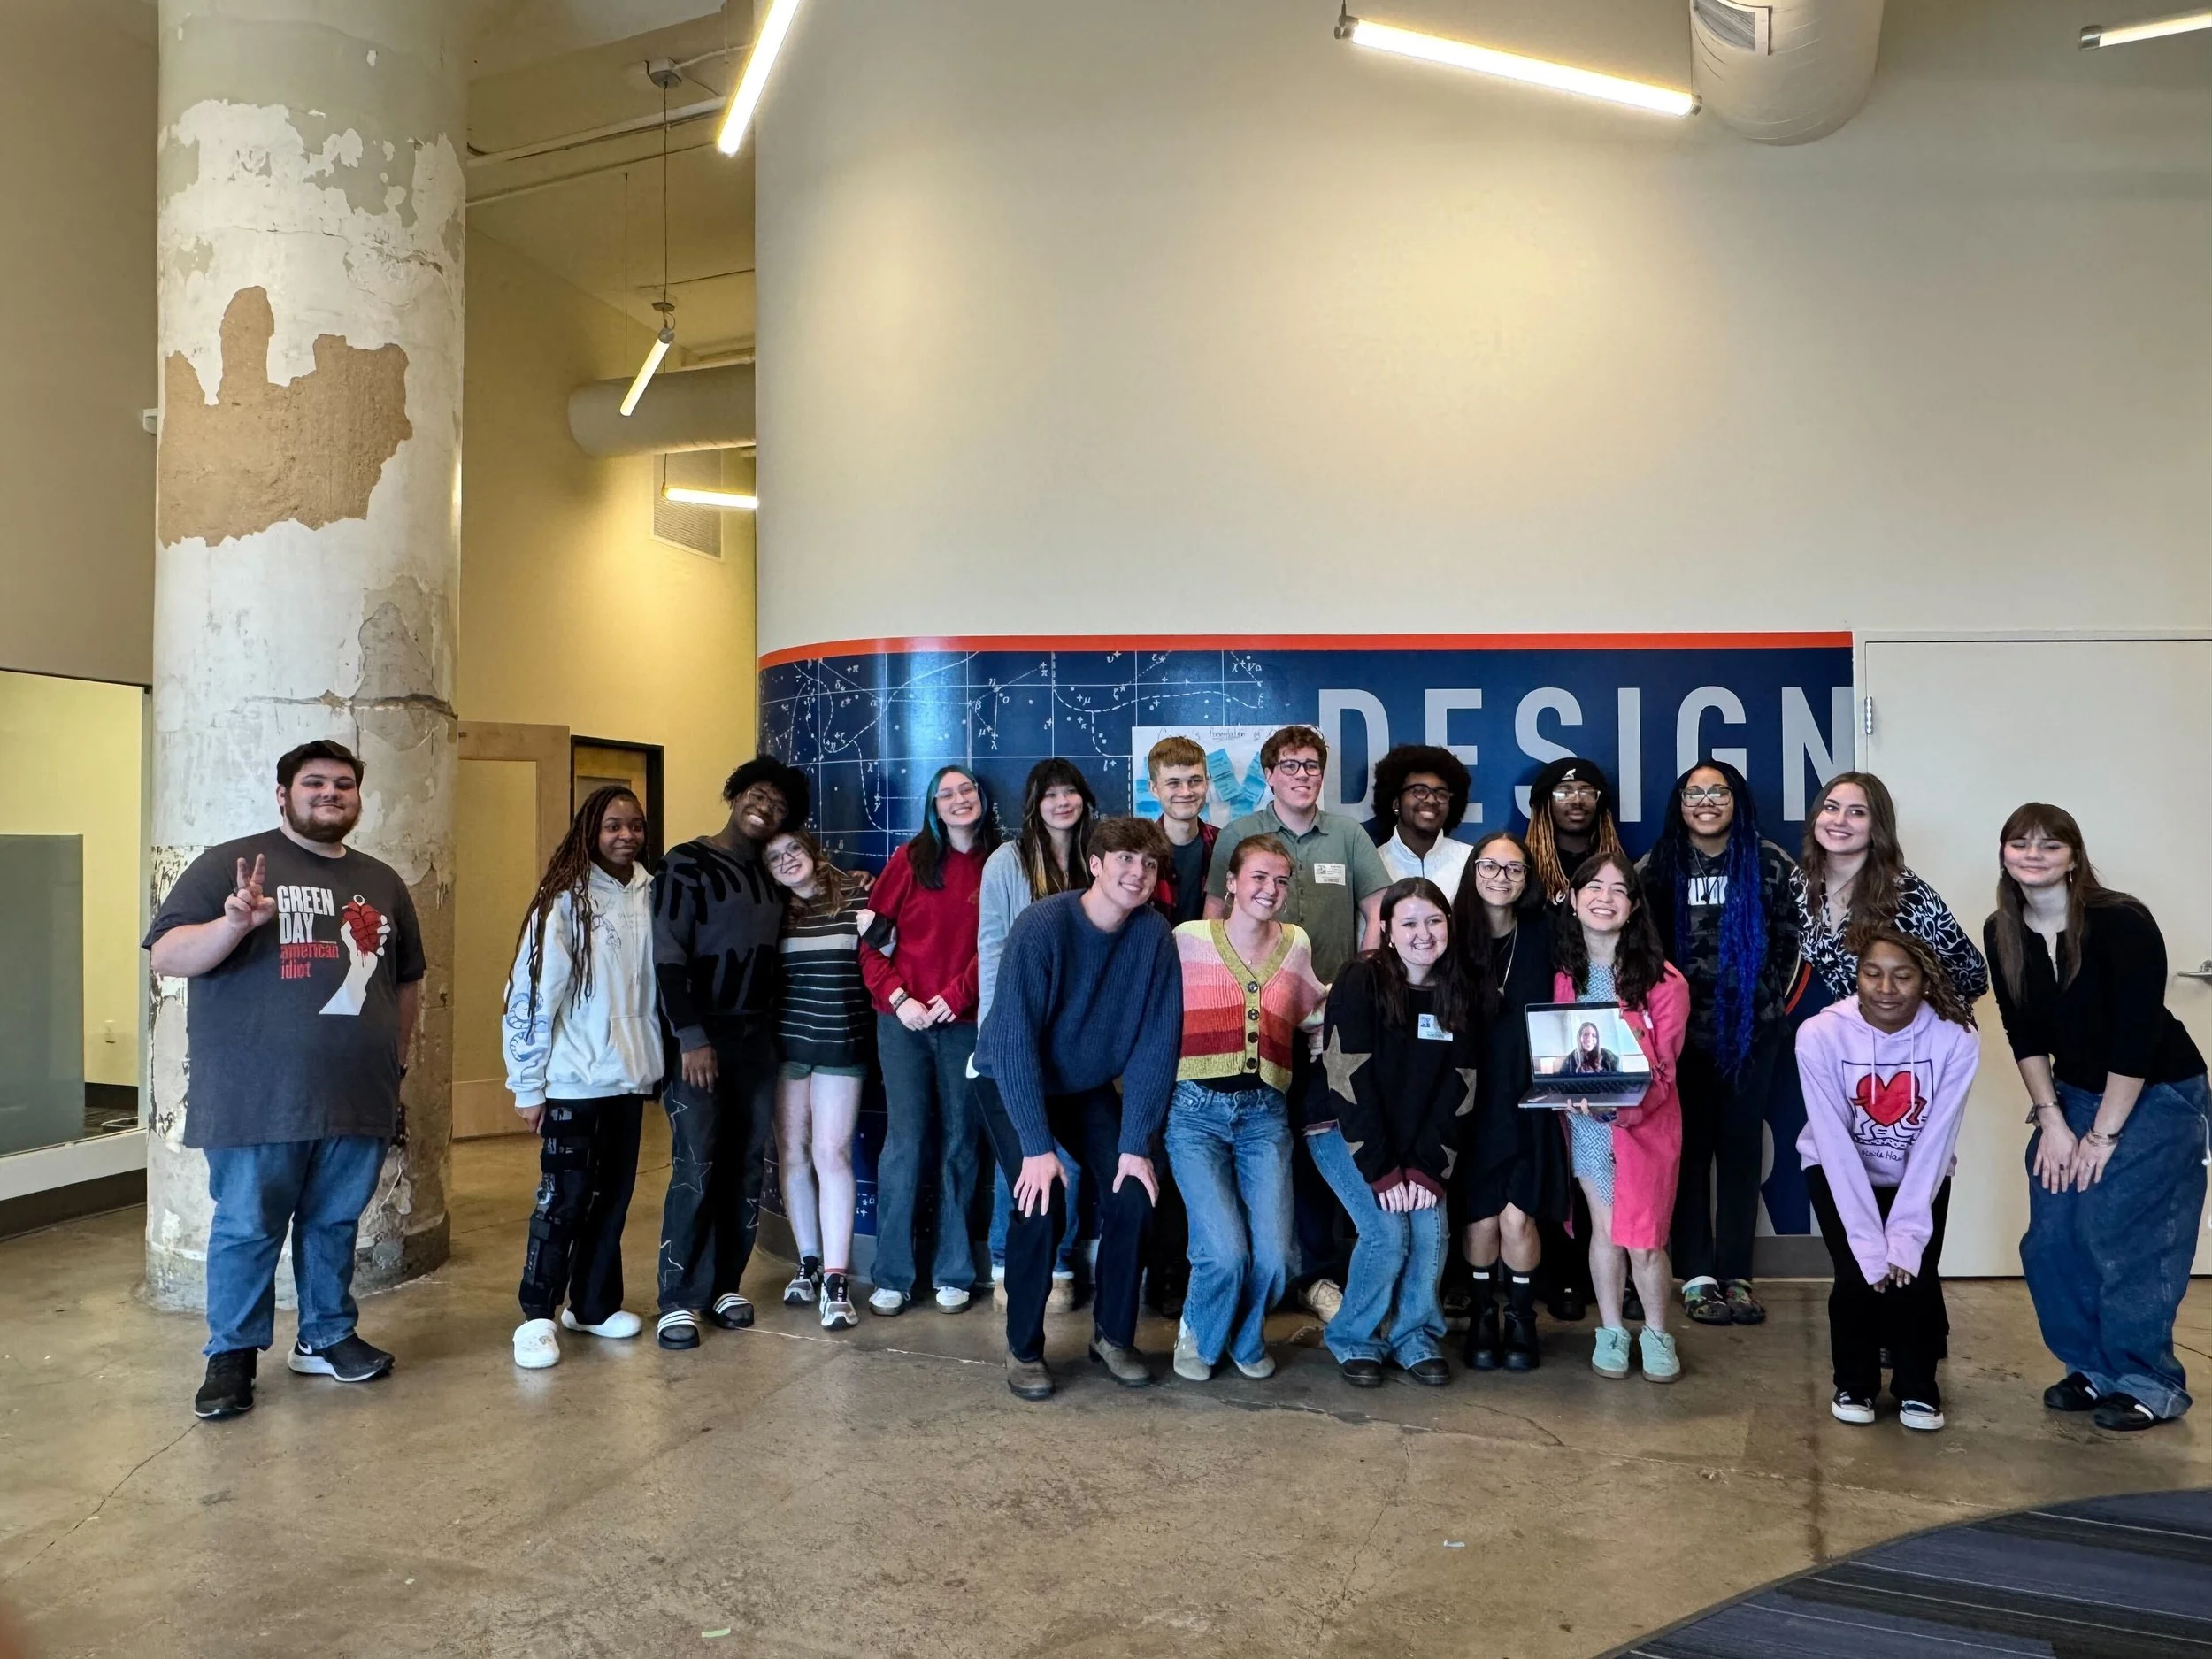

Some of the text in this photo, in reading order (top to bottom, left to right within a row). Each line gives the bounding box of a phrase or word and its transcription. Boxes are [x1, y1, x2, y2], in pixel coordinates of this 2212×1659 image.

[1318, 687, 1855, 824] DESIGN
[277, 886, 335, 916] GREEN
[279, 912, 314, 944] DAY
[280, 944, 339, 958] american
[281, 960, 311, 979] idiot
